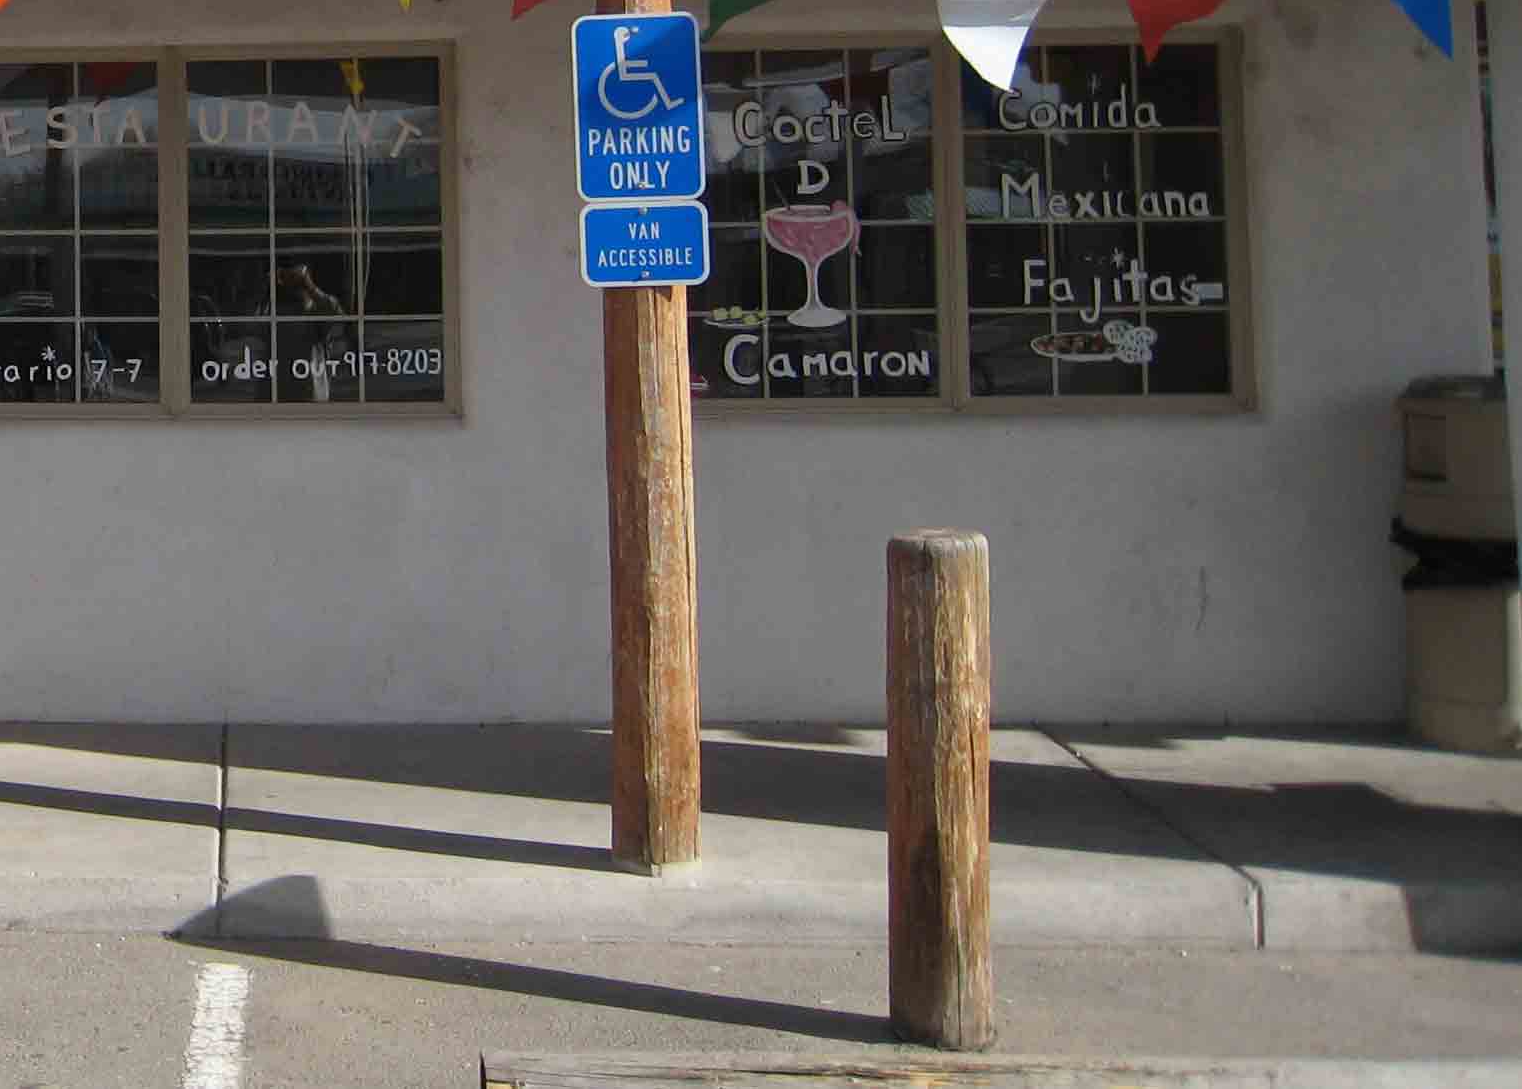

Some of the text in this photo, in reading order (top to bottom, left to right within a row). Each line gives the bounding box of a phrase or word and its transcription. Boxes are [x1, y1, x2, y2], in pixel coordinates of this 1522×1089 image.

[998, 74, 1162, 130] Comida
[588, 125, 691, 156] PARKING
[609, 160, 670, 190] ONLY
[797, 159, 830, 195] D
[1001, 166, 1210, 218] Mexicana
[628, 221, 660, 240] VAN
[597, 246, 693, 267] ACCESSIBLE
[1023, 249, 1200, 323] Fajitas
[89, 358, 144, 383] 7-7
[201, 346, 278, 382] order
